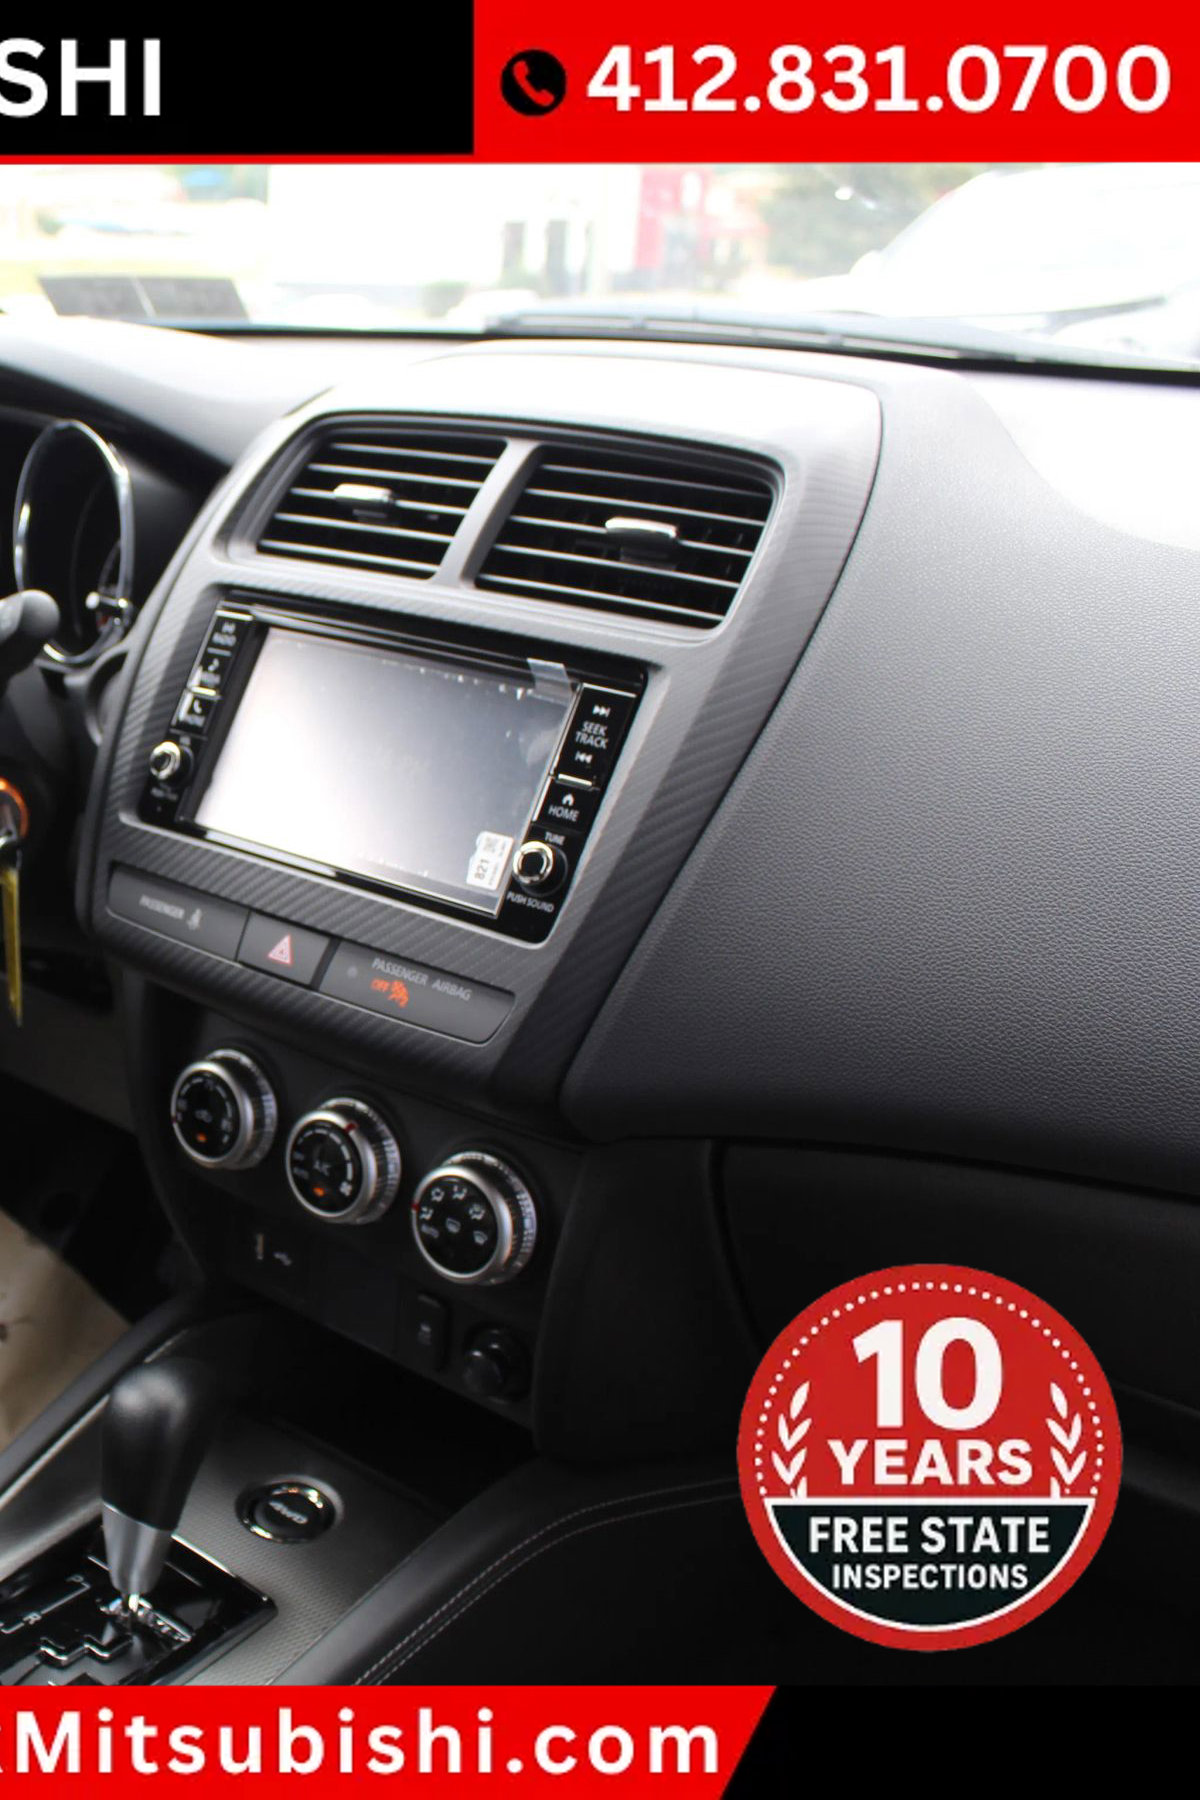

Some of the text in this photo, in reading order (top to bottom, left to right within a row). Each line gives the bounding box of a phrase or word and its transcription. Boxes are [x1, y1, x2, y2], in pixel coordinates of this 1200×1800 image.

[582, 721, 608, 736] SEEK
[575, 731, 609, 749] TRACK
[548, 805, 579, 822] HOME
[506, 890, 555, 913] PUSH SOUND
[371, 957, 473, 1001] PASSENGER AIRBAG
[23, 1612, 42, 1625] R
